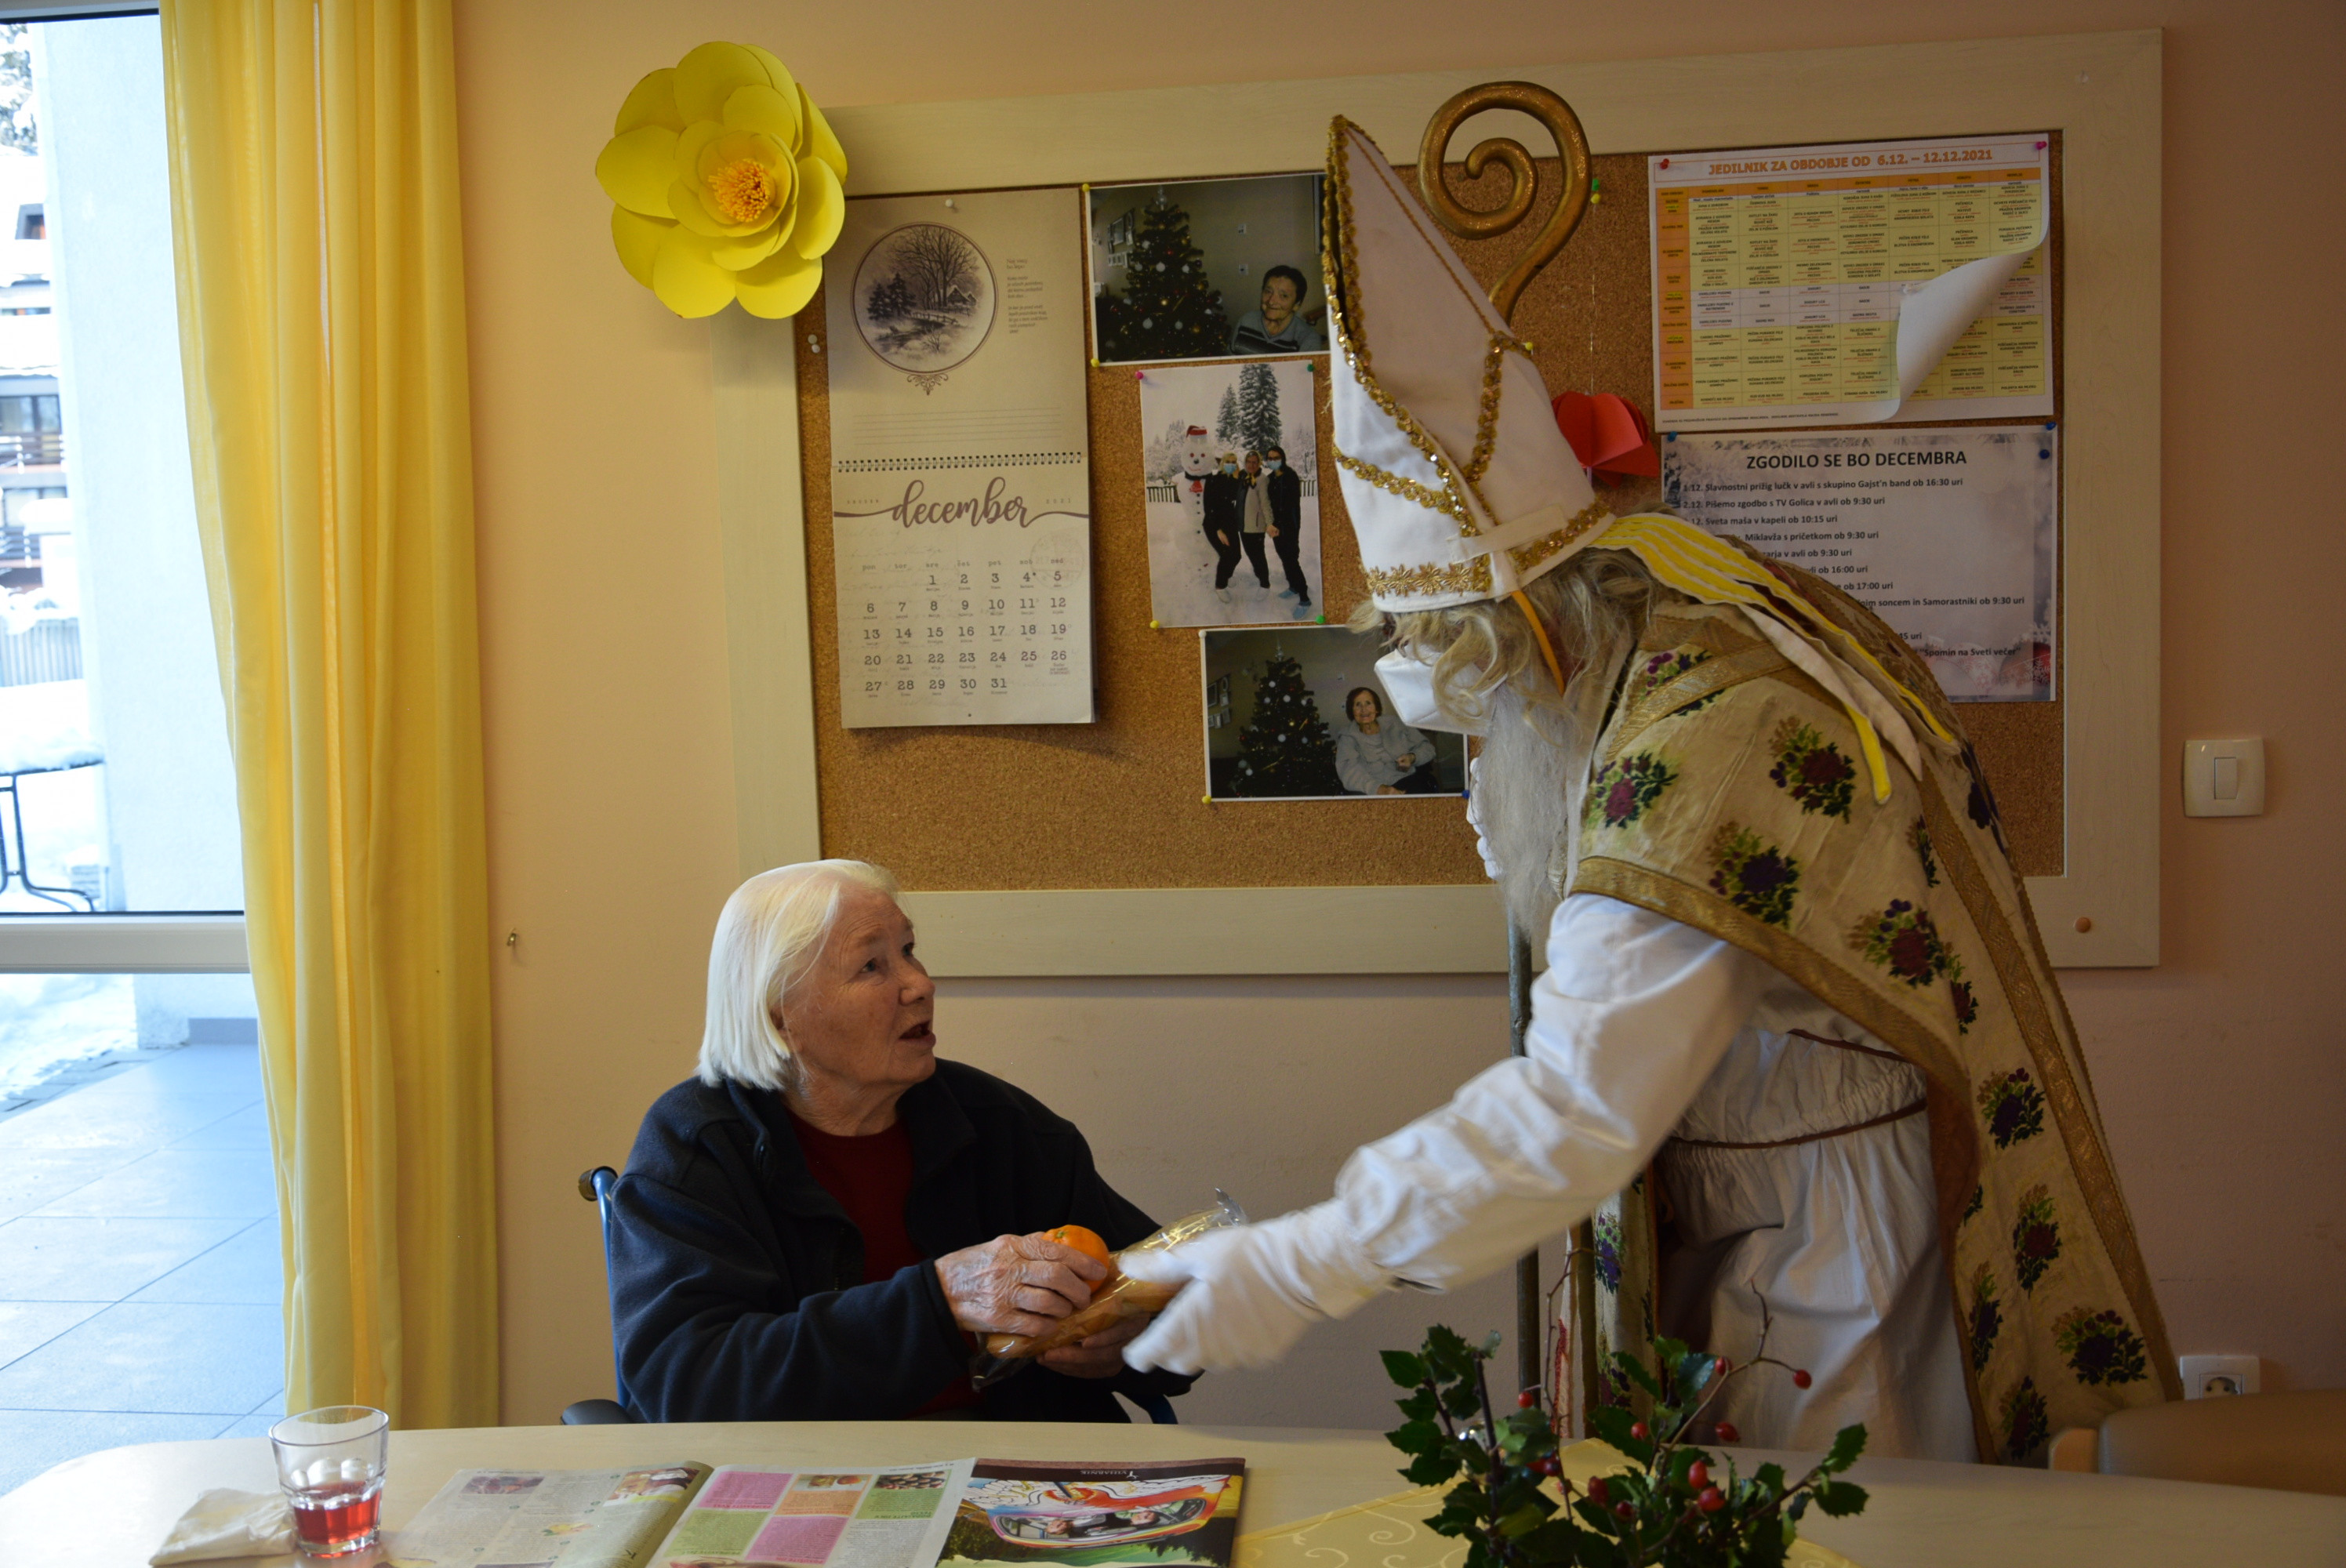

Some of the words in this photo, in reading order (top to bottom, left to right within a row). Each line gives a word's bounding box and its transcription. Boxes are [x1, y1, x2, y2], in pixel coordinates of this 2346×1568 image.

[1709, 161, 1768, 175] JEDILNIK
[1770, 160, 1787, 171] ZA
[1790, 157, 1848, 170] OBDOBJE
[1851, 156, 1870, 166] OD
[1877, 154, 1908, 165] 6.12.
[1923, 149, 1992, 163] 12.12.2021
[1746, 455, 1819, 469] ZGODILO
[1824, 454, 1842, 467] SE
[1847, 453, 1870, 466] BO
[1876, 451, 1967, 466] DECEMBRA
[1705, 483, 1748, 492] Slavnostni
[1750, 482, 1772, 492] prižig
[1774, 481, 1791, 490] lučk
[1823, 480, 1856, 490] skupino
[892, 477, 1027, 528] december
[1738, 499, 1767, 509] zgodbo
[1761, 516, 1786, 526] kapeli
[1826, 514, 1838, 523] uri
[1789, 532, 1832, 542] pričetkom
[1763, 550, 1781, 558] arja
[929, 575, 936, 585] 1
[961, 574, 968, 584] 2
[991, 573, 1000, 583] 3
[1022, 572, 1030, 582] 4
[1054, 571, 1062, 581] 5
[1856, 582, 1879, 590] 17:00
[866, 603, 874, 613] 6
[899, 602, 906, 612] 7
[930, 601, 938, 611] 8
[961, 600, 969, 610] 9
[988, 599, 1004, 610] 10
[1019, 598, 1035, 608] 11
[1051, 597, 1066, 608] 12
[1923, 597, 1977, 606] Samorastniki
[863, 629, 881, 640] 13
[895, 628, 912, 638] 14
[927, 627, 943, 637] 15
[958, 626, 975, 637] 16
[990, 626, 1005, 636] 17
[1020, 625, 1037, 635] 18
[1051, 623, 1066, 634] 19
[864, 655, 881, 666] 20
[896, 654, 913, 664] 21
[928, 653, 945, 663] 22
[959, 652, 975, 662] 23
[990, 652, 1006, 662] 24
[1021, 651, 1037, 661] 25
[1051, 650, 1066, 661] 26
[1970, 648, 1992, 656] Sveti
[865, 681, 882, 691] 27
[897, 680, 914, 691] 28
[929, 680, 946, 690] 29
[960, 679, 976, 689] 30
[991, 678, 1007, 688] 31
